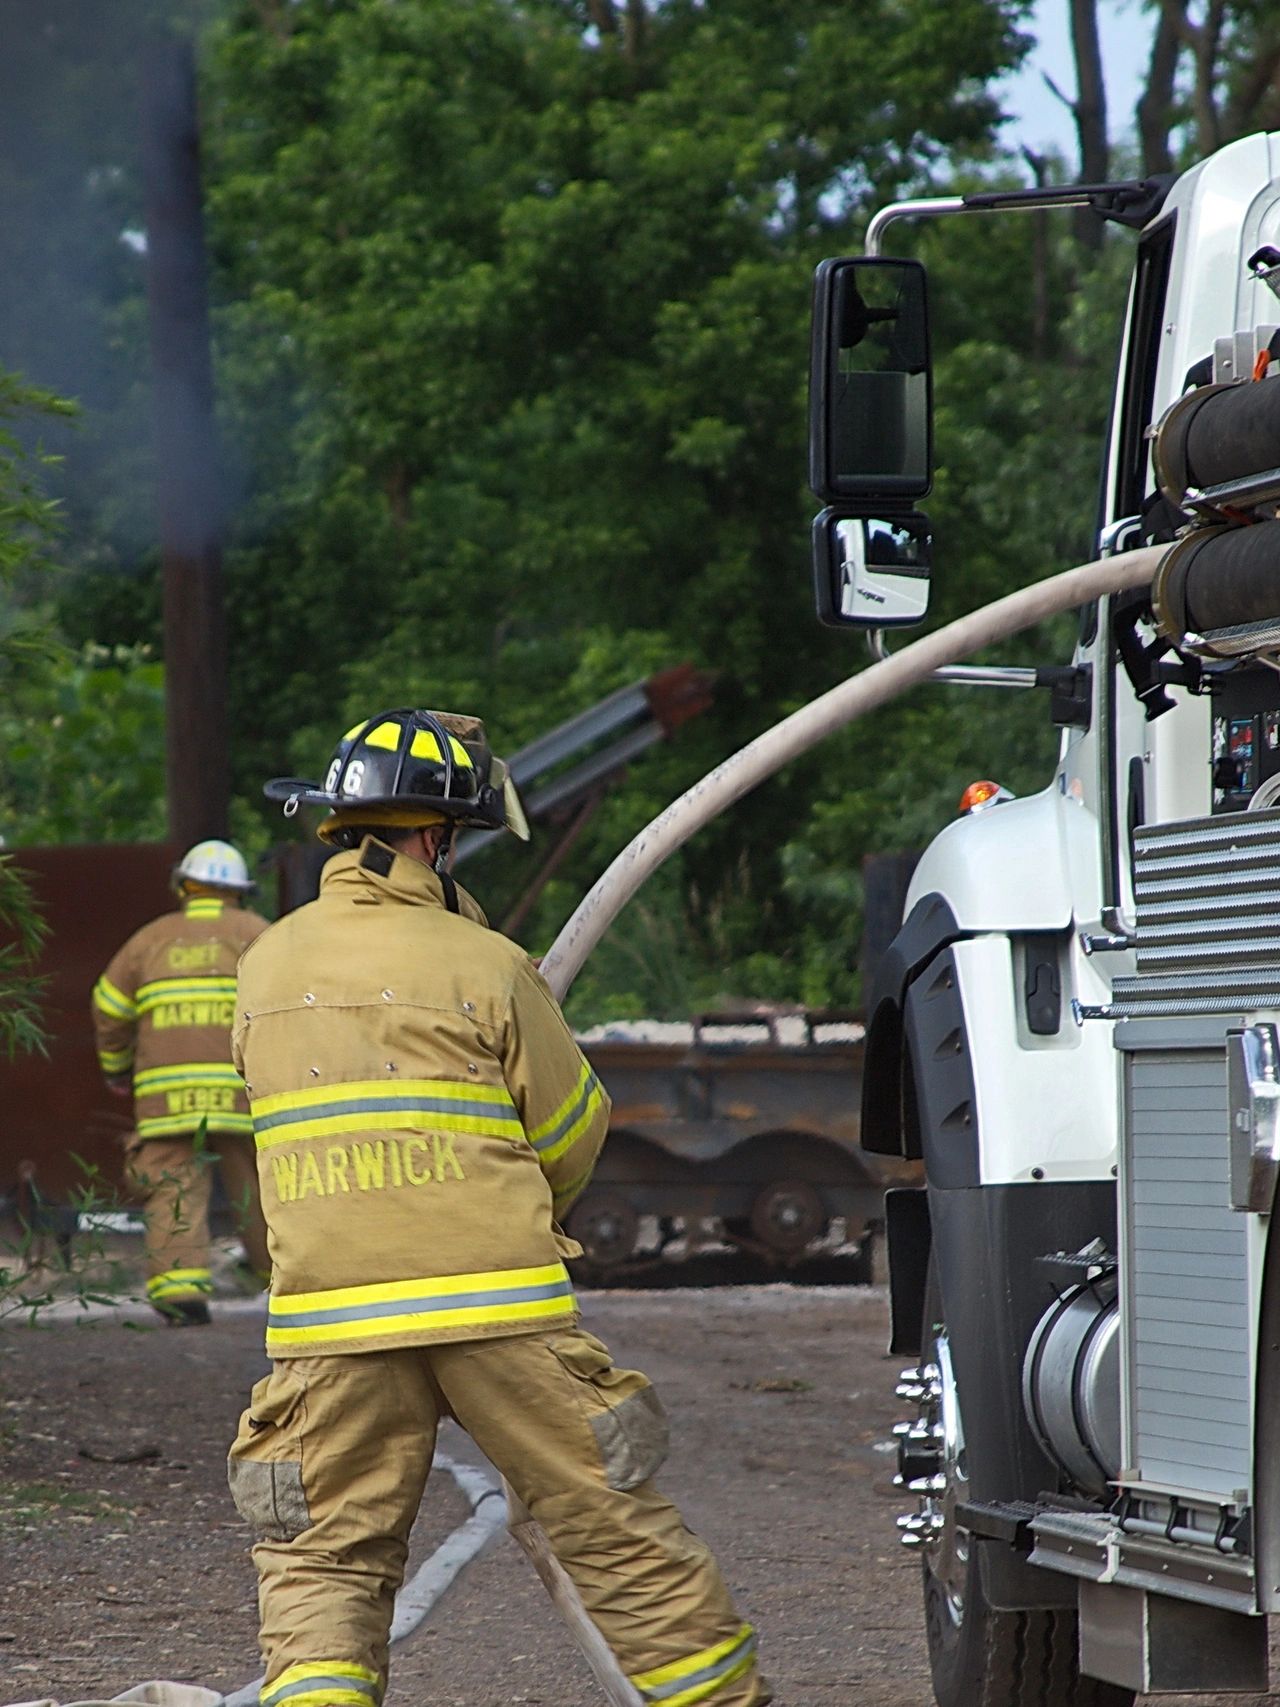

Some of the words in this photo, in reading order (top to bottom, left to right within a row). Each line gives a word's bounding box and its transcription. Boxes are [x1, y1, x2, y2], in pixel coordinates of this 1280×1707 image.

[325, 758, 365, 795] 66
[152, 1001, 236, 1030] WARWIC
[166, 1088, 235, 1113] WEBER
[271, 1133, 466, 1203] WARWICK
